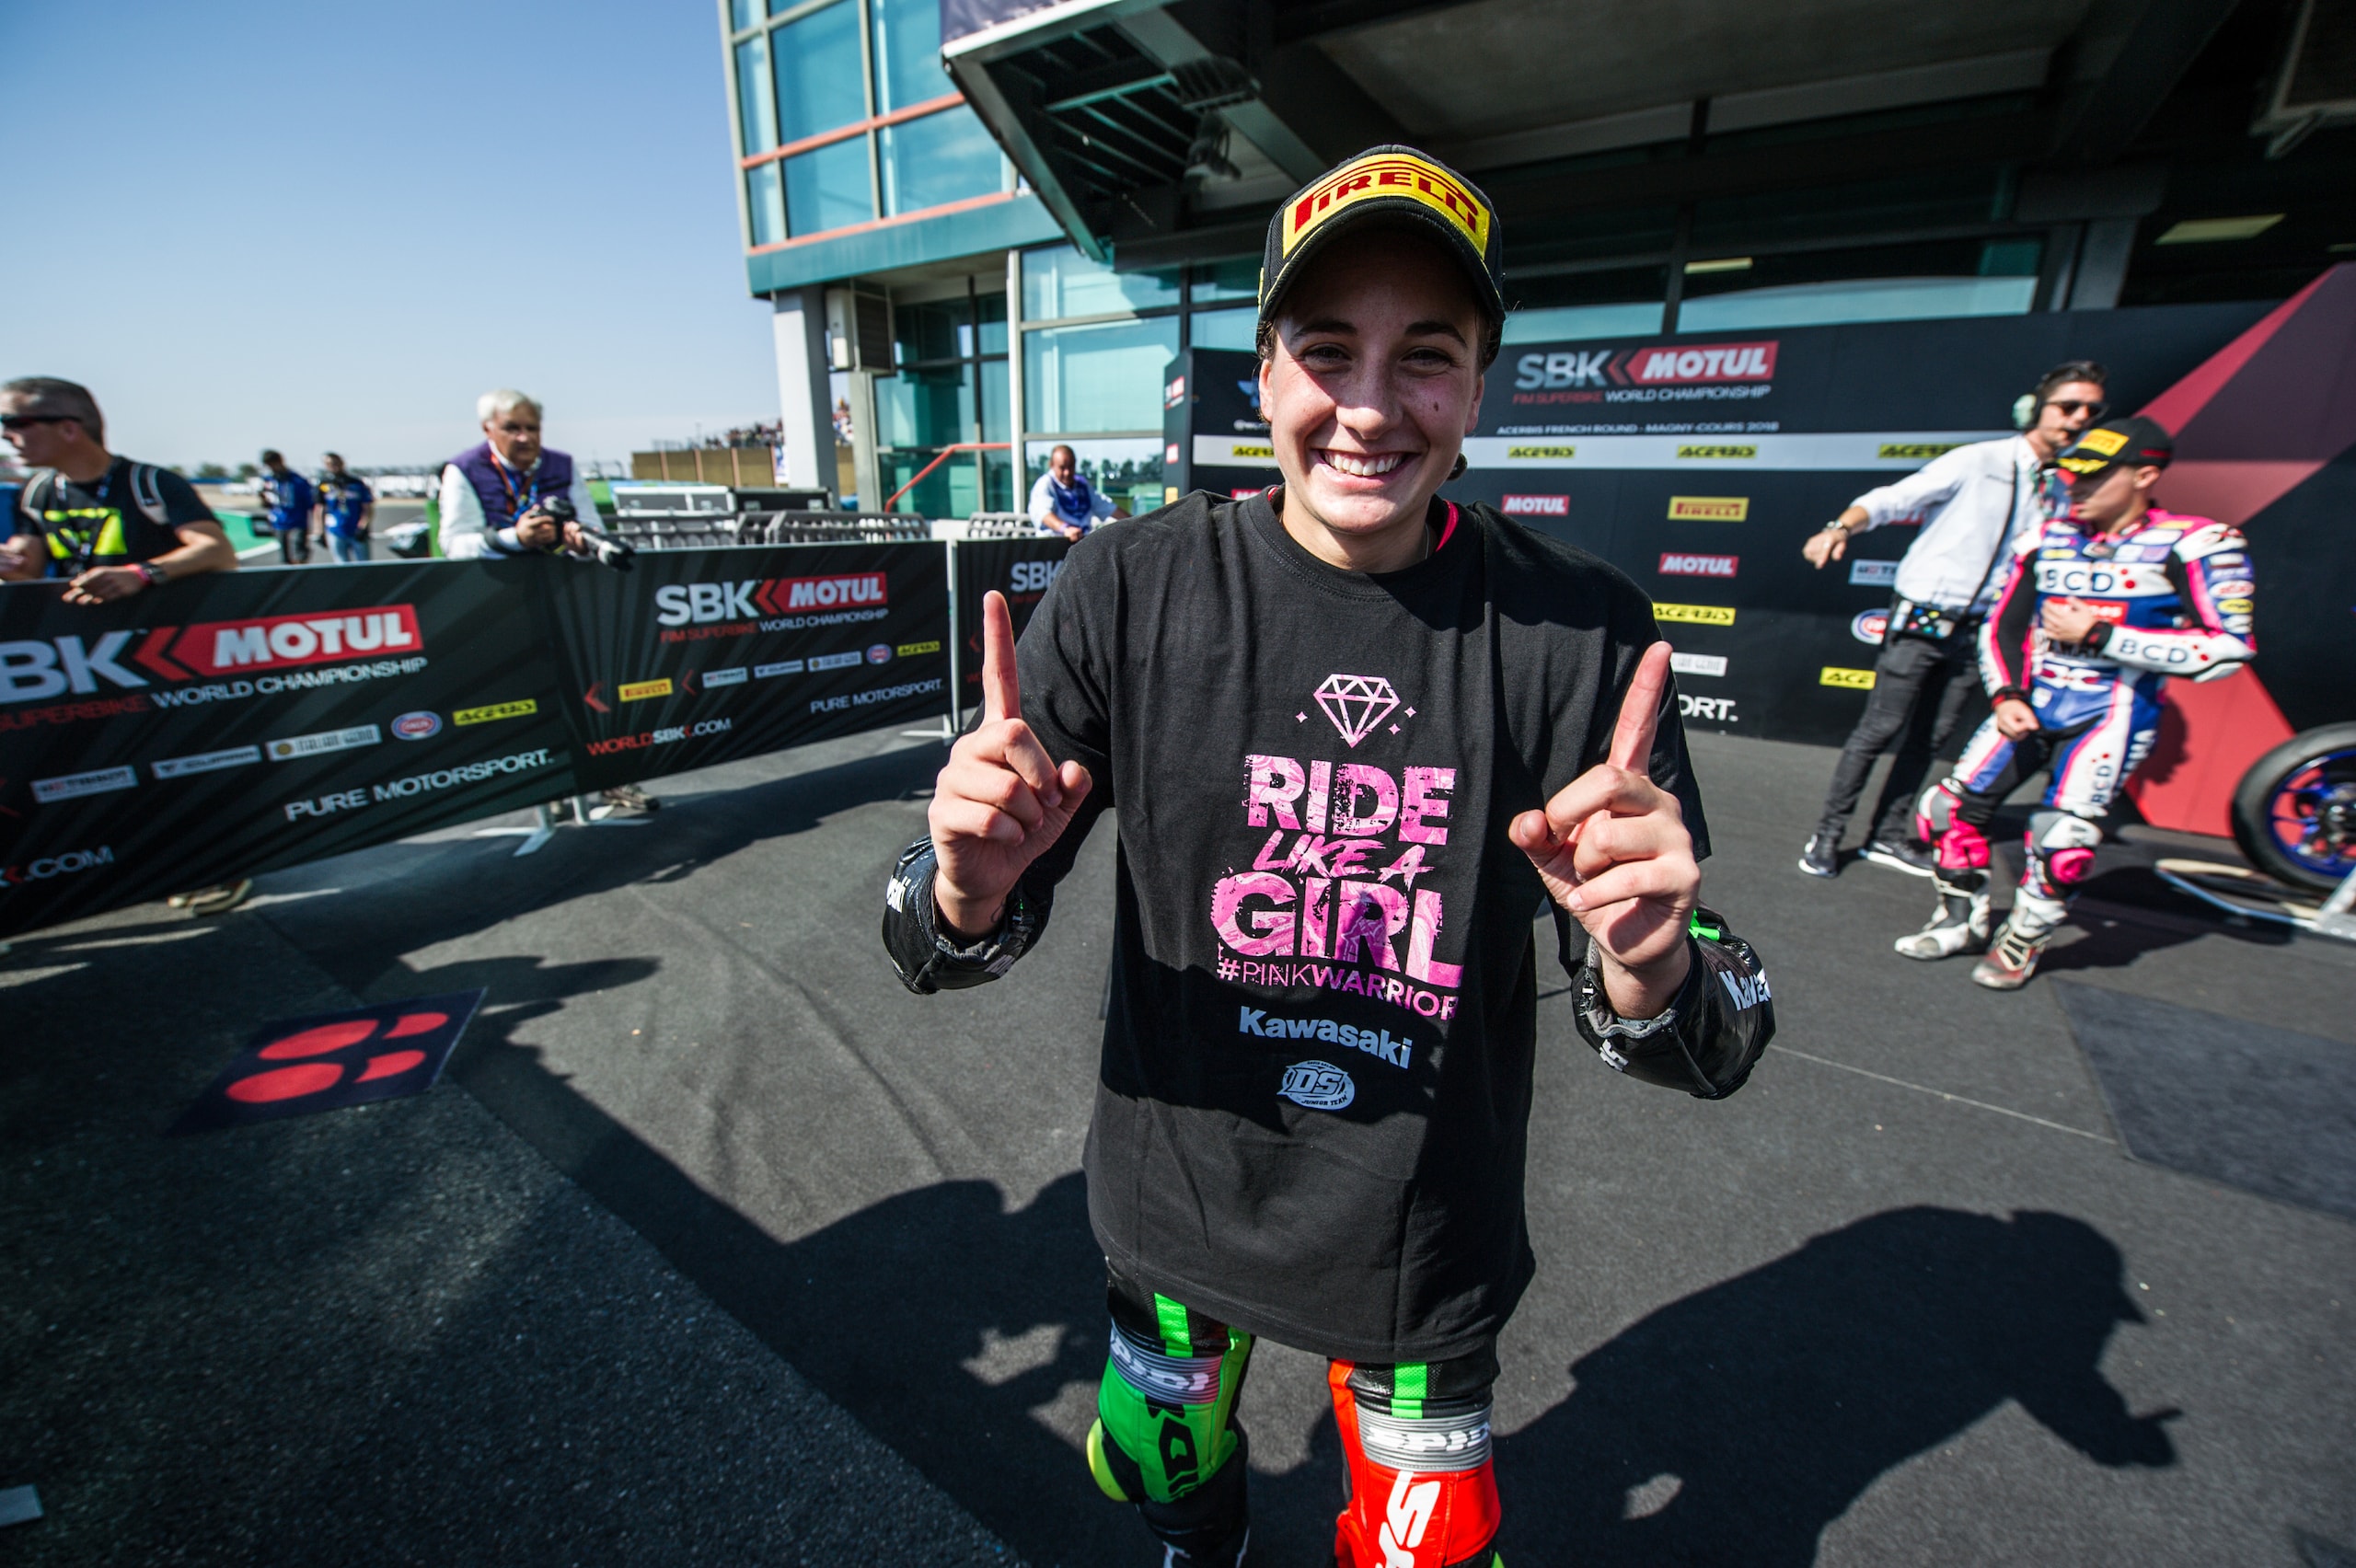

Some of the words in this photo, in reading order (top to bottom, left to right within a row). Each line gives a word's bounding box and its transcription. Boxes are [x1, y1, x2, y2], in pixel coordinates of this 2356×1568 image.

[1295, 161, 1478, 234] PIRELLI
[1515, 351, 1611, 389] SBK
[1641, 347, 1769, 380] MOTUL
[1605, 387, 1657, 403] WORLD
[1657, 385, 1773, 401] CHAMPIONSHIP
[1505, 497, 1566, 513] MOTUL
[1676, 502, 1742, 517] PIRELLI
[1663, 555, 1734, 575] MOTUL
[655, 580, 759, 627] SBK
[789, 577, 884, 608] MOTUL
[759, 617, 805, 632] WORLD
[806, 608, 889, 628] CHAMPIONSHIP
[213, 612, 412, 668] MOTUL
[2119, 639, 2188, 664] BCD
[150, 680, 255, 709] WORLD
[255, 656, 428, 694] CHAMPIONSHIP
[811, 695, 850, 713] PURE
[853, 678, 943, 706] MOTORSPORT.
[285, 789, 368, 822] PURE
[373, 748, 556, 802] MOTORSPORT.
[1242, 754, 1457, 846] RIDE
[1252, 830, 1386, 879] LIKE
[1378, 845, 1435, 891] A
[1210, 870, 1464, 988] GIRL
[1239, 1006, 1413, 1069] Kawasaki
[1288, 1068, 1344, 1095] DS
[1330, 1094, 1347, 1106] TEAM
